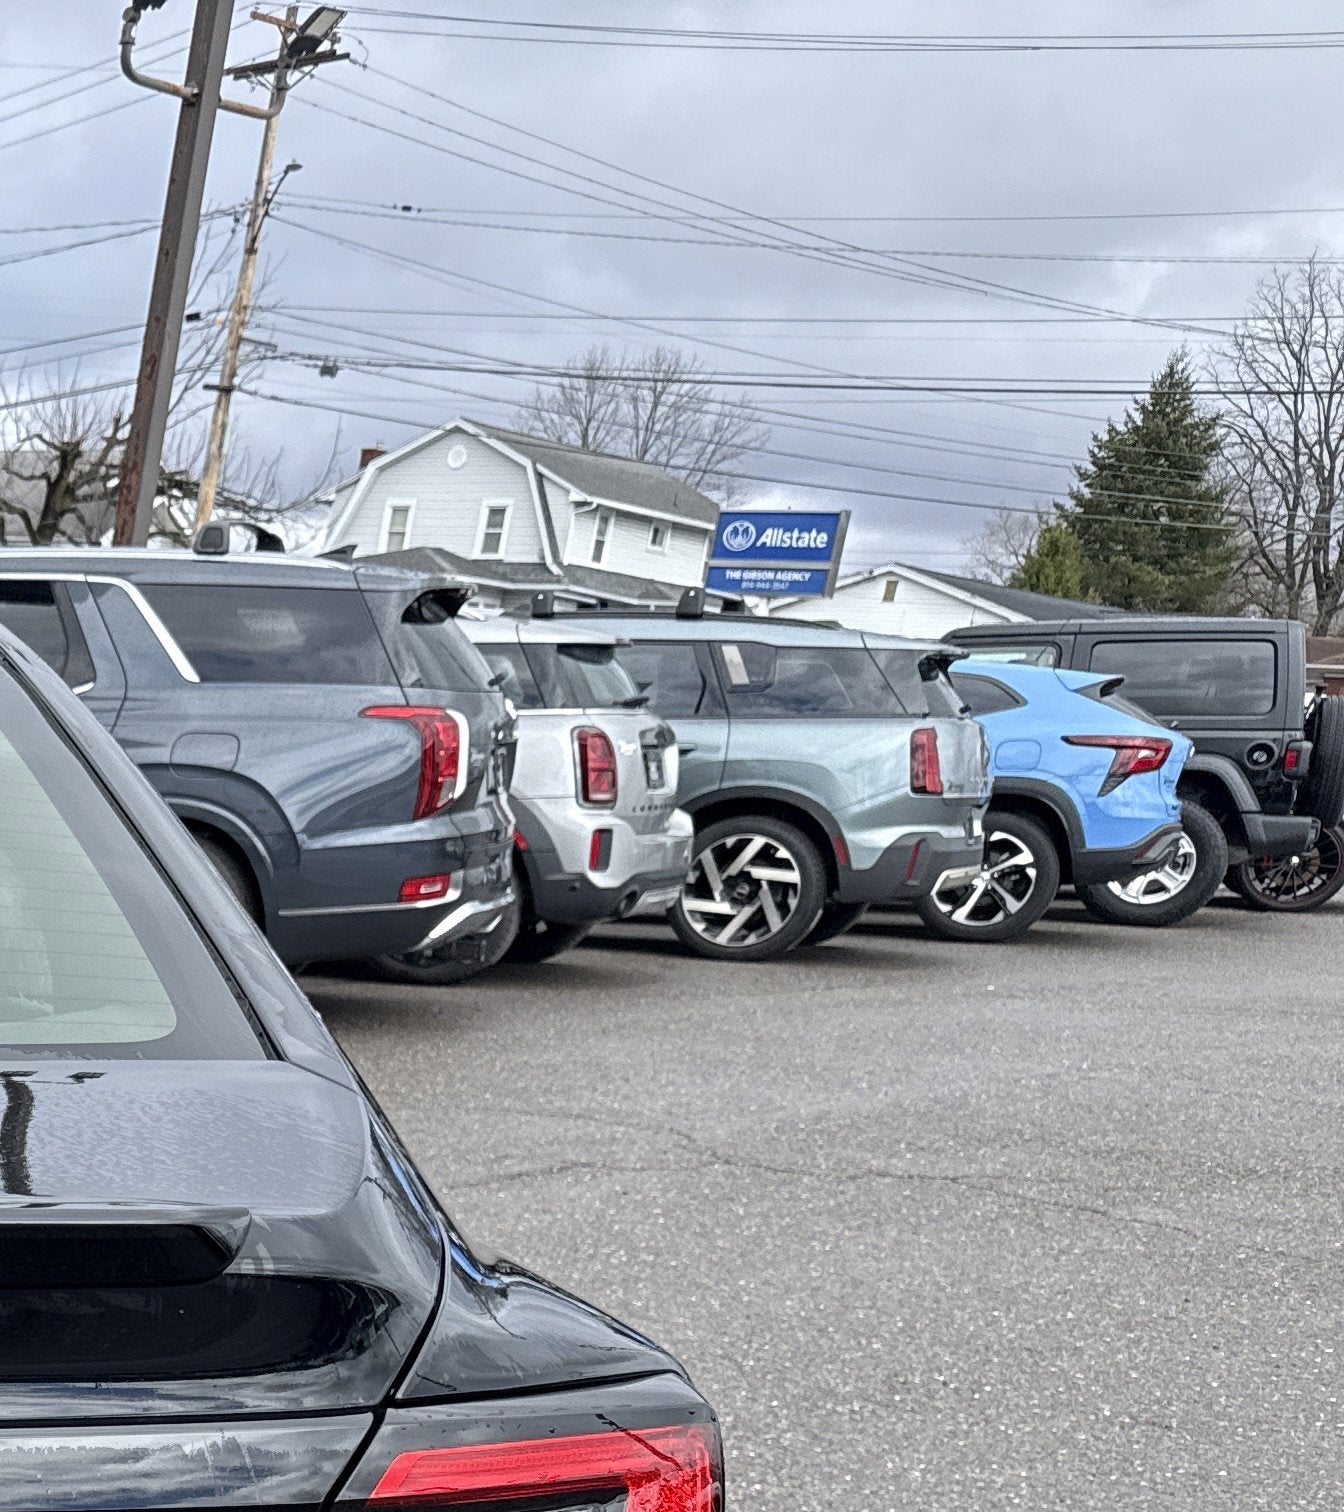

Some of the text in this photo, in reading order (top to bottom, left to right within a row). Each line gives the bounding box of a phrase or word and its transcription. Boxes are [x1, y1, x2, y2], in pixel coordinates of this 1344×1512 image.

[756, 527, 829, 549] Allstate
[725, 568, 742, 580] THE
[775, 570, 812, 582] AGENCY
